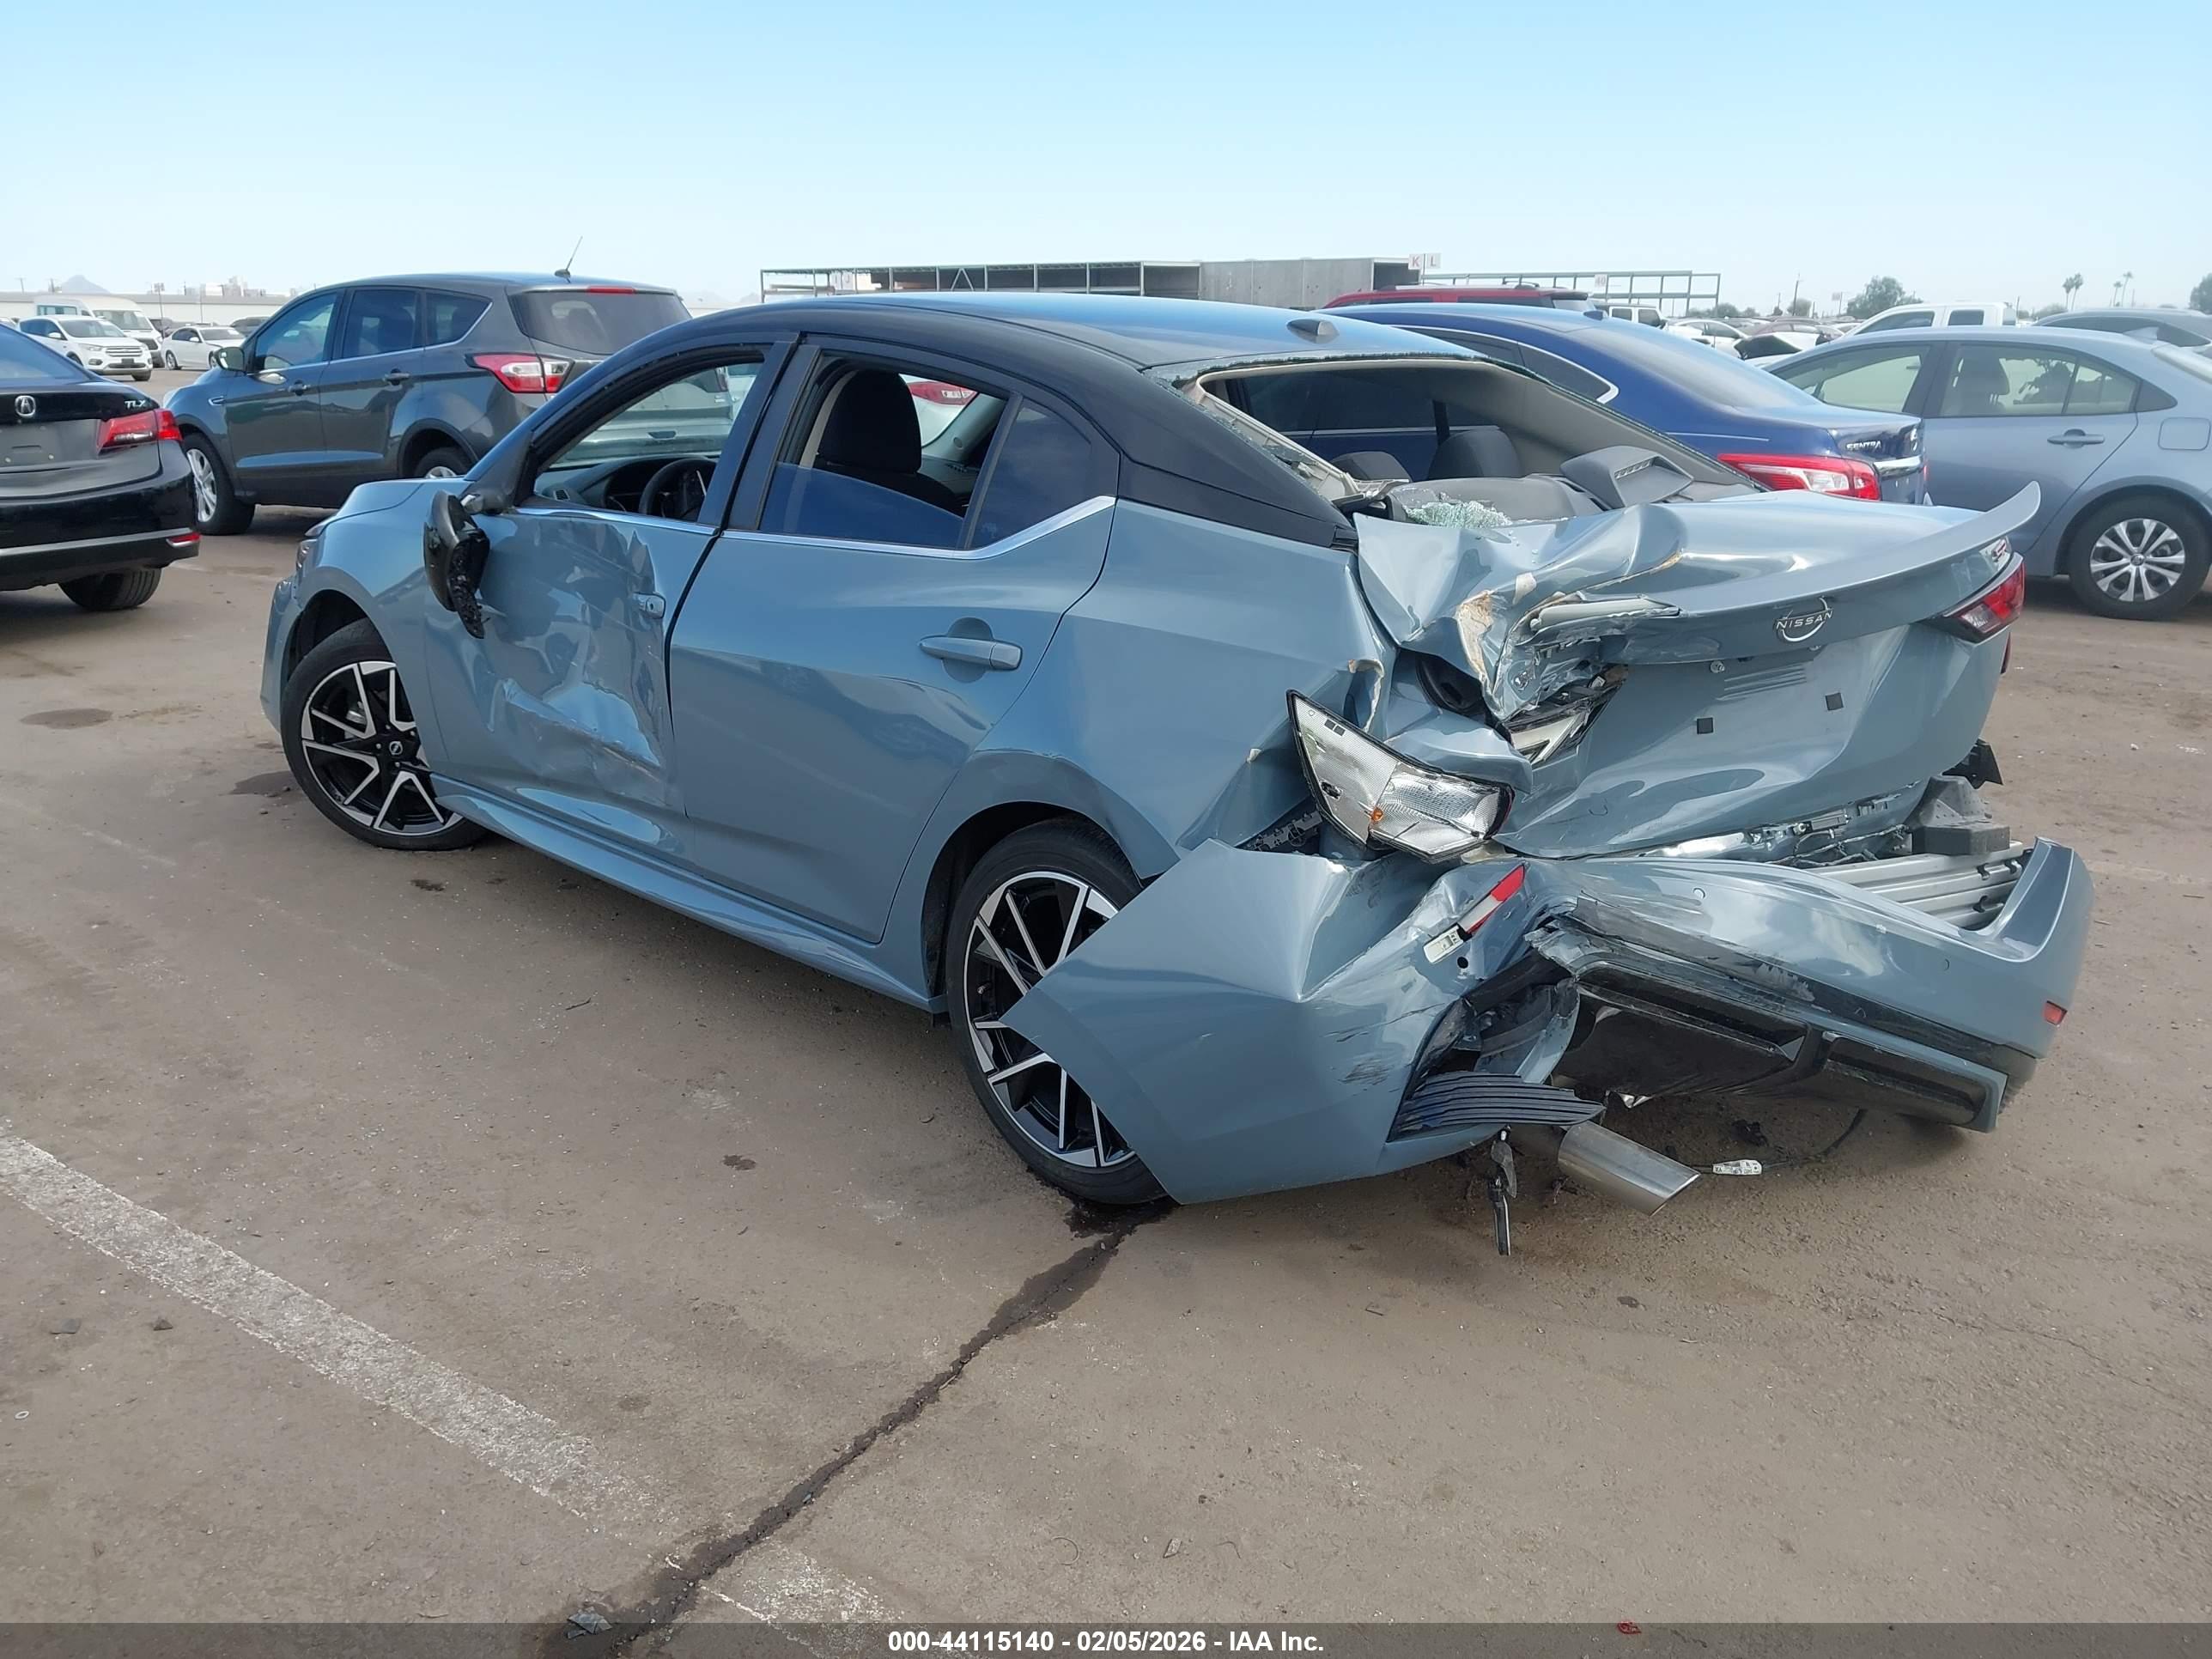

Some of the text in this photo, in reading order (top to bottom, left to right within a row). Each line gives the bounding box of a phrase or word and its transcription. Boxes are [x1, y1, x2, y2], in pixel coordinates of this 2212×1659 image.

[1413, 256, 1420, 267] K
[1431, 256, 1437, 266] L
[124, 399, 146, 409] TLX
[1846, 441, 1882, 451] SENTRA
[1776, 609, 1833, 629] NISSAN
